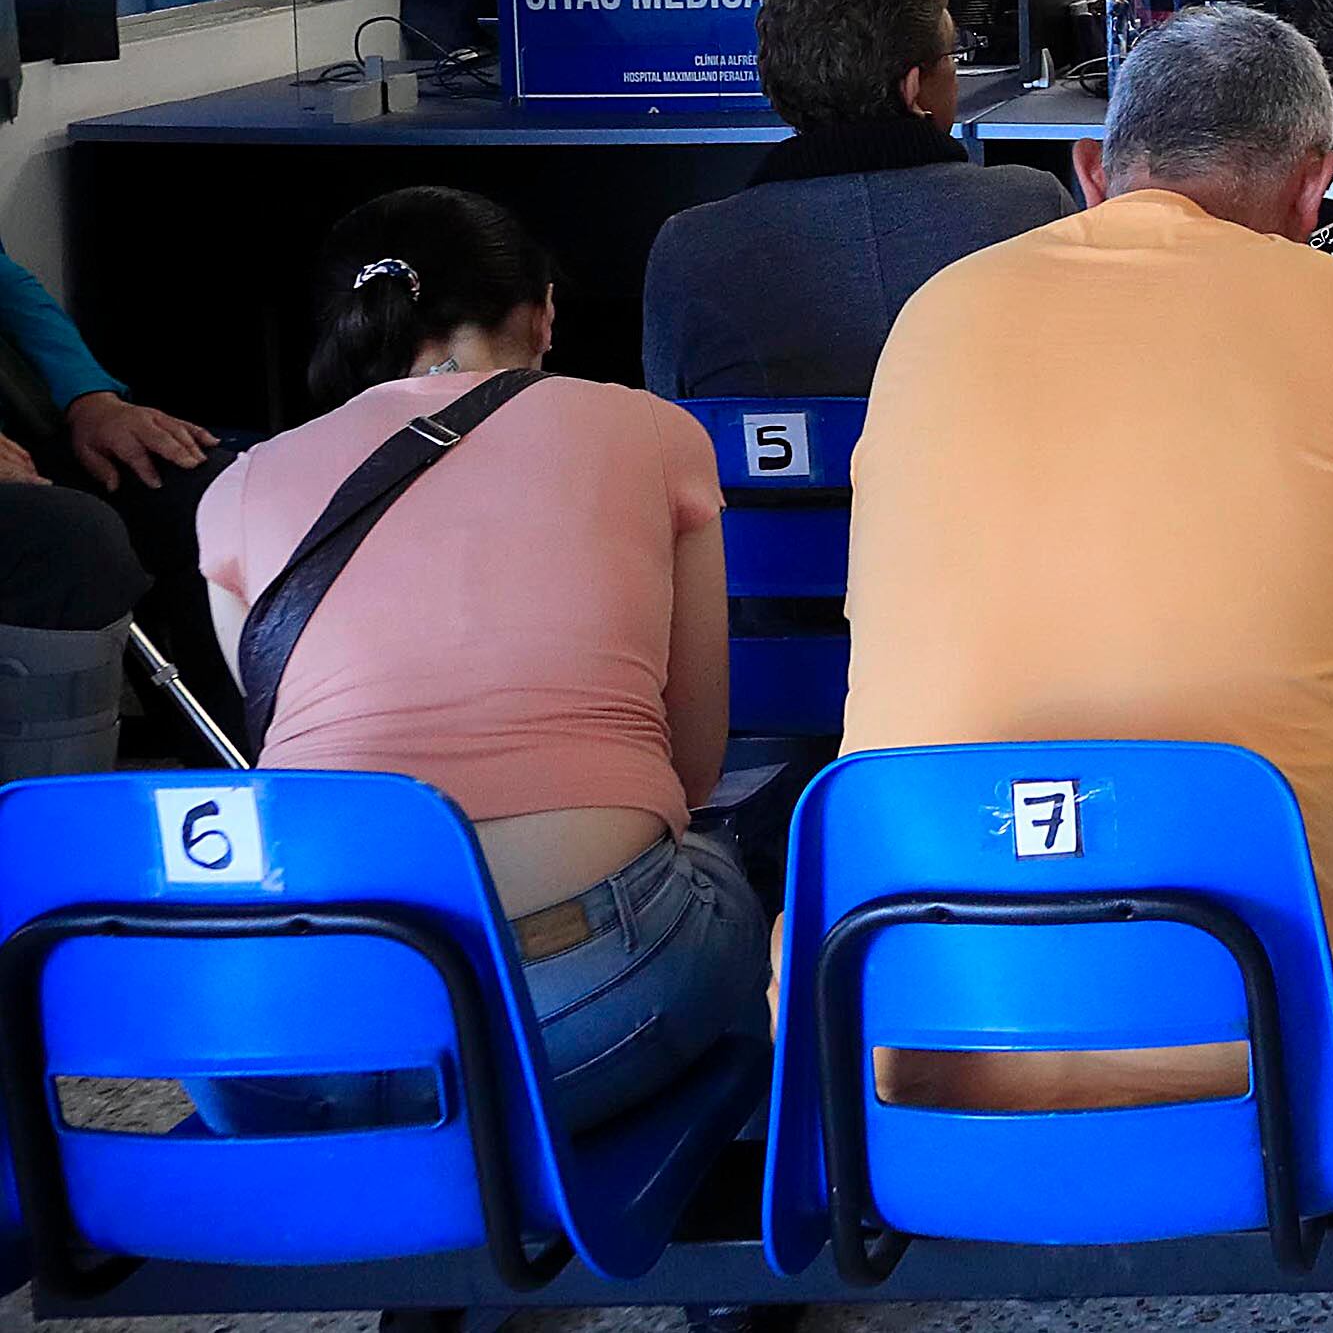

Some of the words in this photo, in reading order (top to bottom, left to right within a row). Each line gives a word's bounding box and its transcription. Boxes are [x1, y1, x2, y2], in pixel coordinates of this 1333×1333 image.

[756, 425, 793, 470] 5
[182, 800, 232, 870] 6
[1023, 793, 1066, 849] 7
